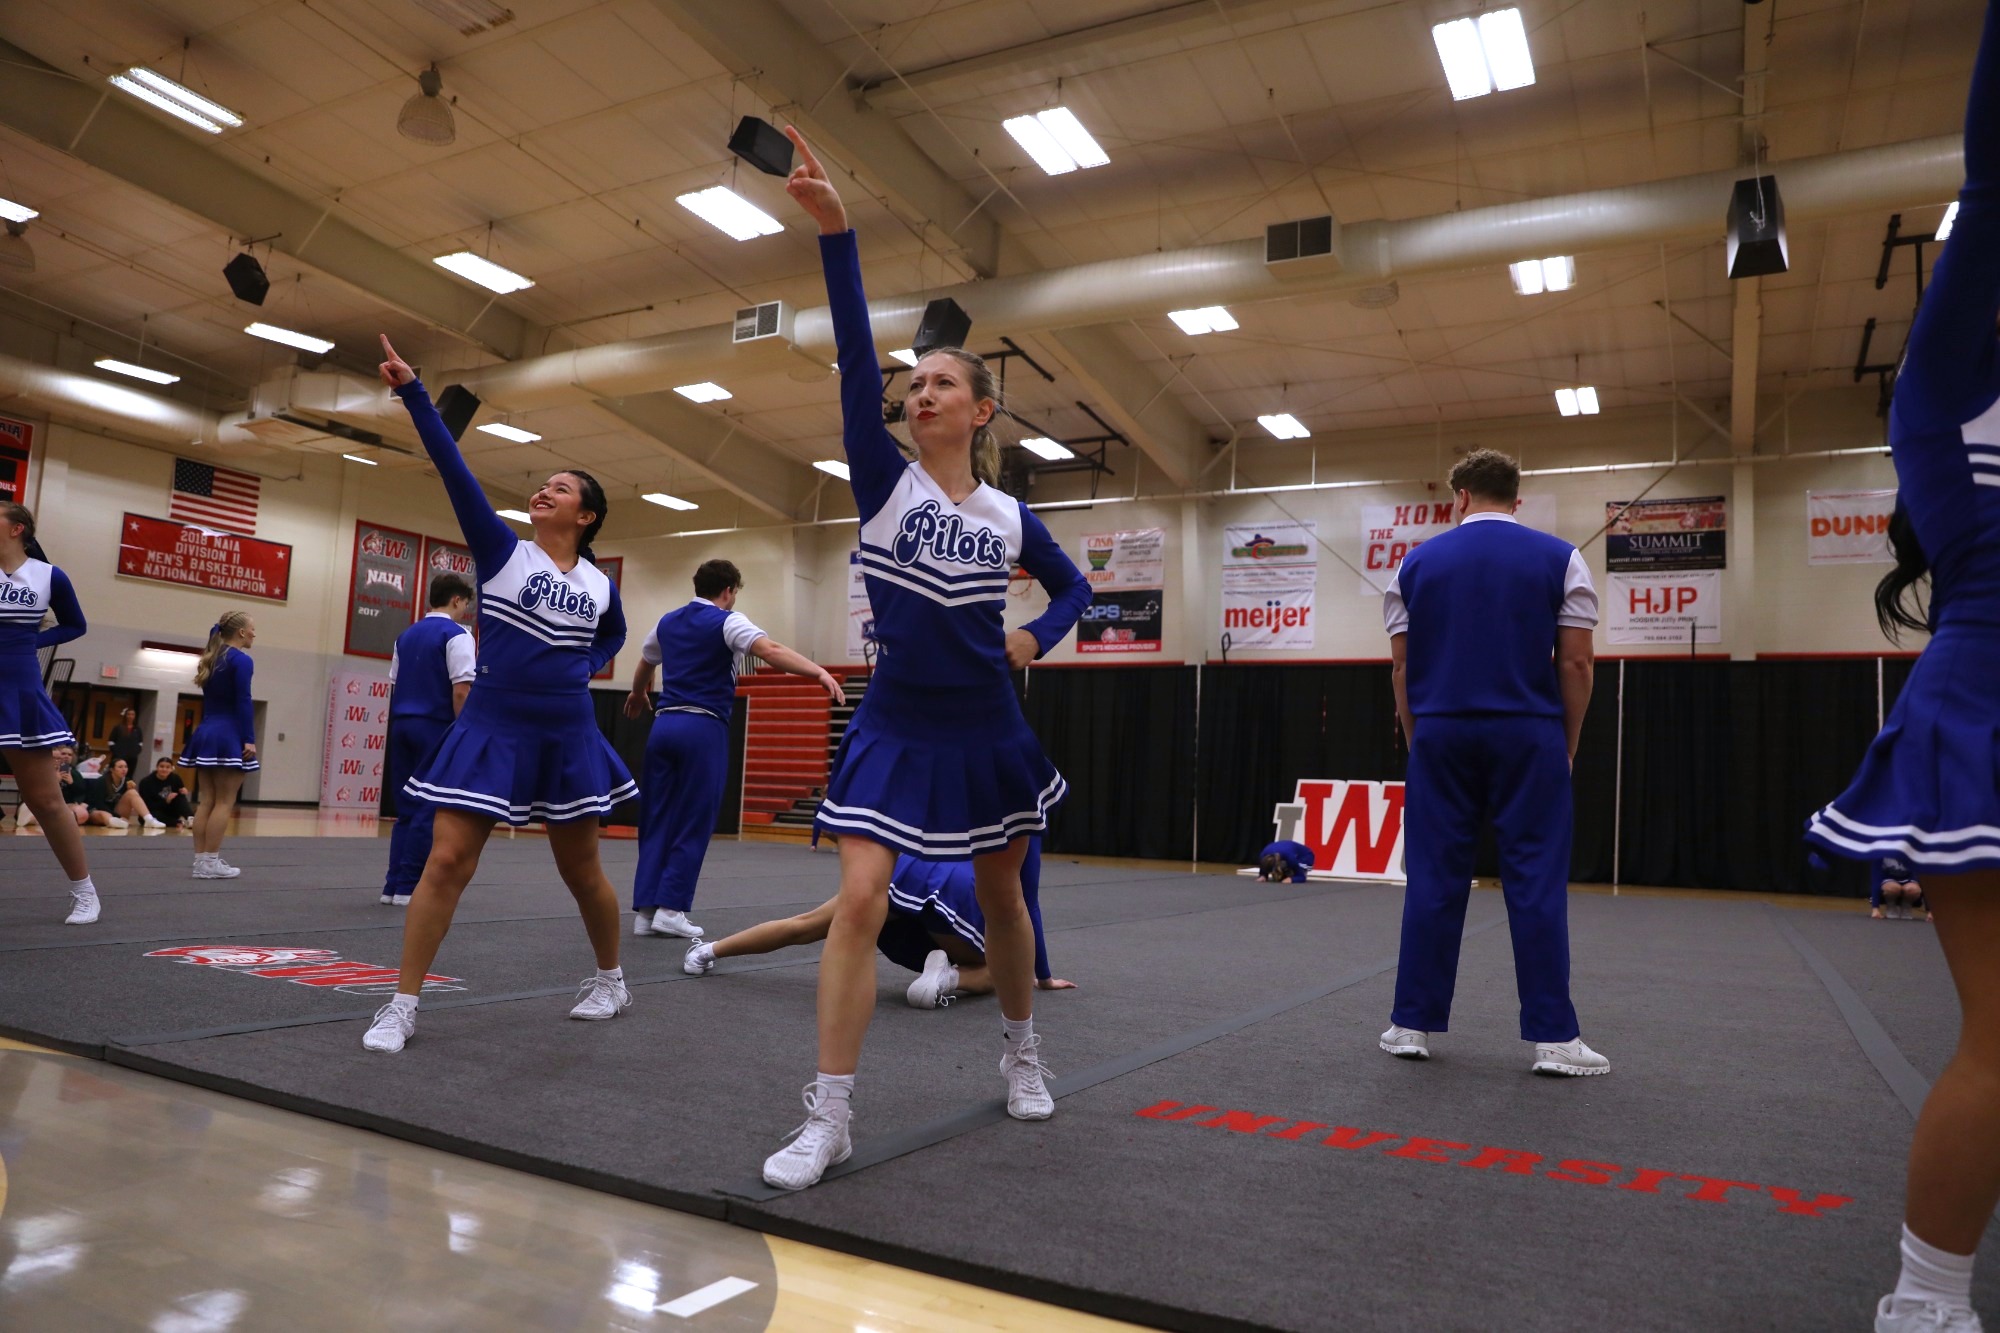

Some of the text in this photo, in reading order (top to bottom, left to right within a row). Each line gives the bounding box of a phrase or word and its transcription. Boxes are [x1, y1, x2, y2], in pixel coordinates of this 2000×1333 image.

[180, 530, 241, 552] 2018 NAIA
[892, 500, 1006, 569] Pilots
[1370, 528, 1394, 540] THE
[1629, 534, 1703, 549] SUMMIT
[175, 542, 241, 564] DIVISION II
[380, 538, 411, 560] IWU
[143, 563, 267, 593] NATIONAL CHAMPION
[147, 550, 266, 581] MEN'S BASKETBALL
[366, 569, 404, 594] NAIA
[0, 582, 38, 607] lots
[518, 571, 597, 622] Pilots
[1629, 587, 1698, 614] HJP
[358, 607, 379, 617] 2017
[1224, 600, 1311, 634] meijer
[344, 706, 370, 722] IWU
[339, 759, 365, 775] IWU
[1277, 783, 1407, 874] IW
[1133, 1100, 1854, 1217] UNIVERSITY
